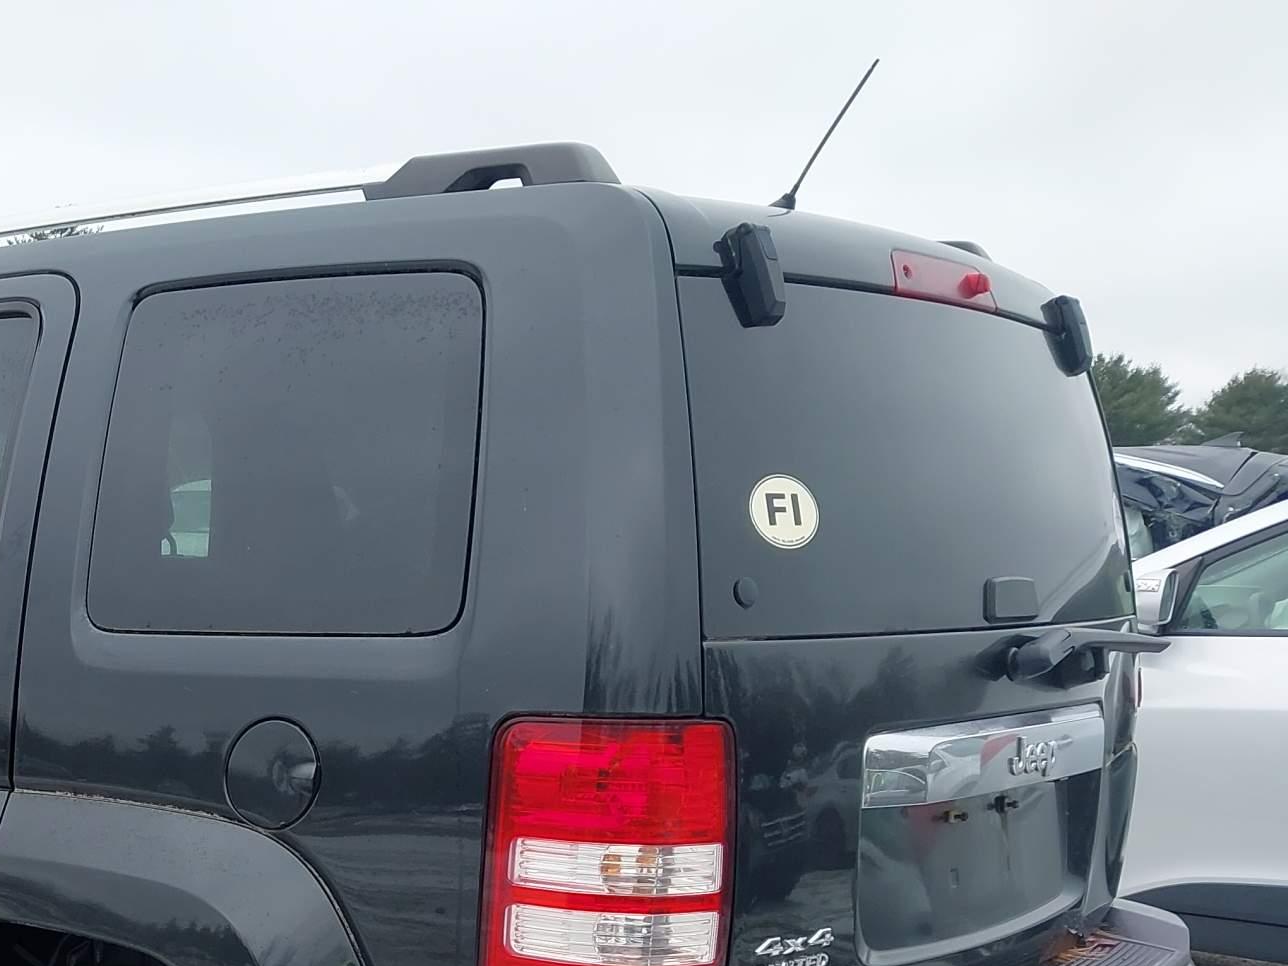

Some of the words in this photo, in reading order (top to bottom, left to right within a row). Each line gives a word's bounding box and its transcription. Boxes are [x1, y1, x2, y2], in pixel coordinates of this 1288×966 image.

[765, 492, 802, 526] FI
[1008, 735, 1058, 777] Jeep
[754, 927, 835, 957] 4x4
